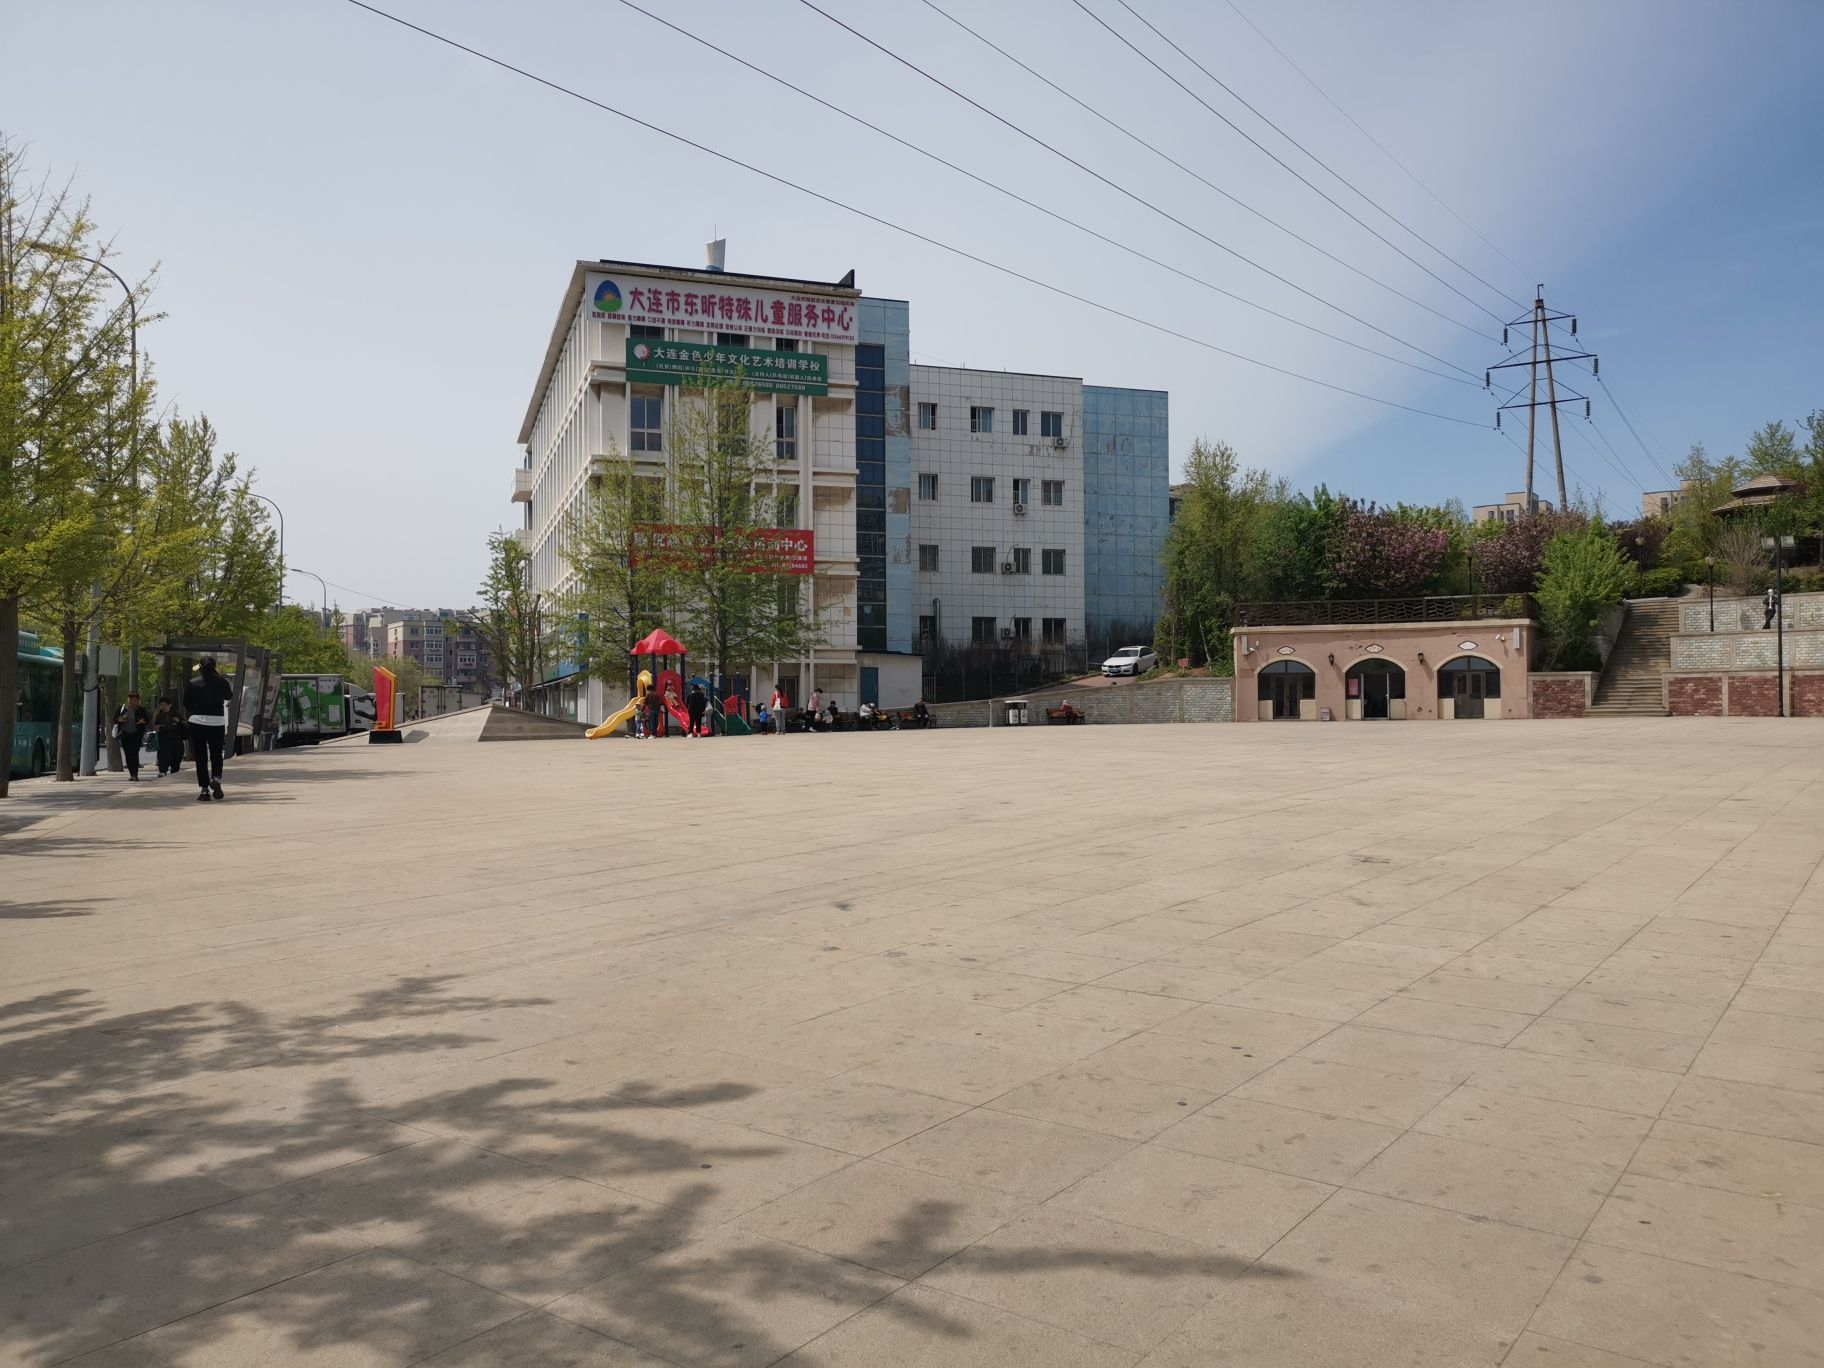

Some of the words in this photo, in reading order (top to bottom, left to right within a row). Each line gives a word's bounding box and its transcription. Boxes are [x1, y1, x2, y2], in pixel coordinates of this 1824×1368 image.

[629, 286, 854, 332] 大连市东昕特殊儿童服务中心
[654, 346, 820, 372] 大连金色少年文化艺术培训学校
